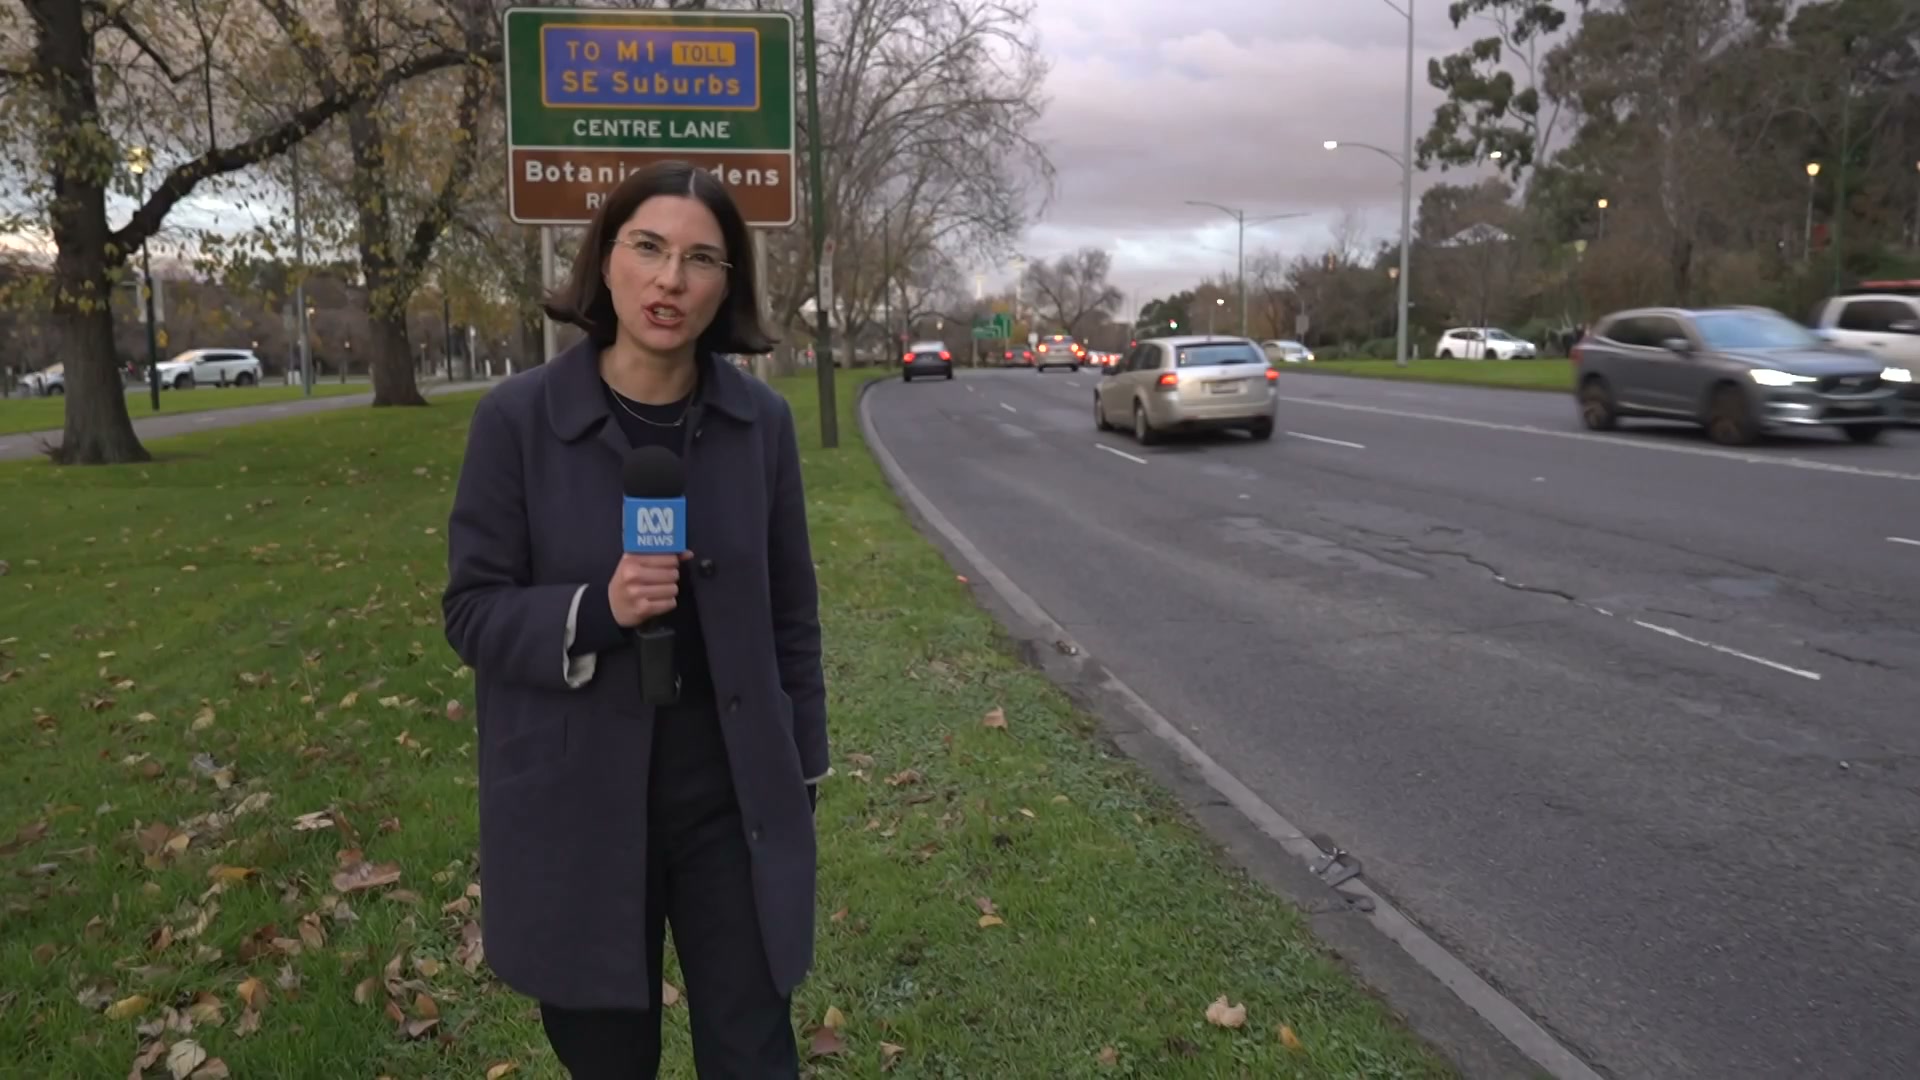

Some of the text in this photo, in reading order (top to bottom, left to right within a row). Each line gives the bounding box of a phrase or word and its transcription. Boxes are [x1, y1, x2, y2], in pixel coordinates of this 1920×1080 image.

[566, 40, 728, 63] TO M1 TOLL
[562, 70, 741, 96] SE Suburbs
[573, 119, 731, 139] CENTRE LANE
[708, 163, 780, 187] dens
[637, 535, 674, 547] NEWS
